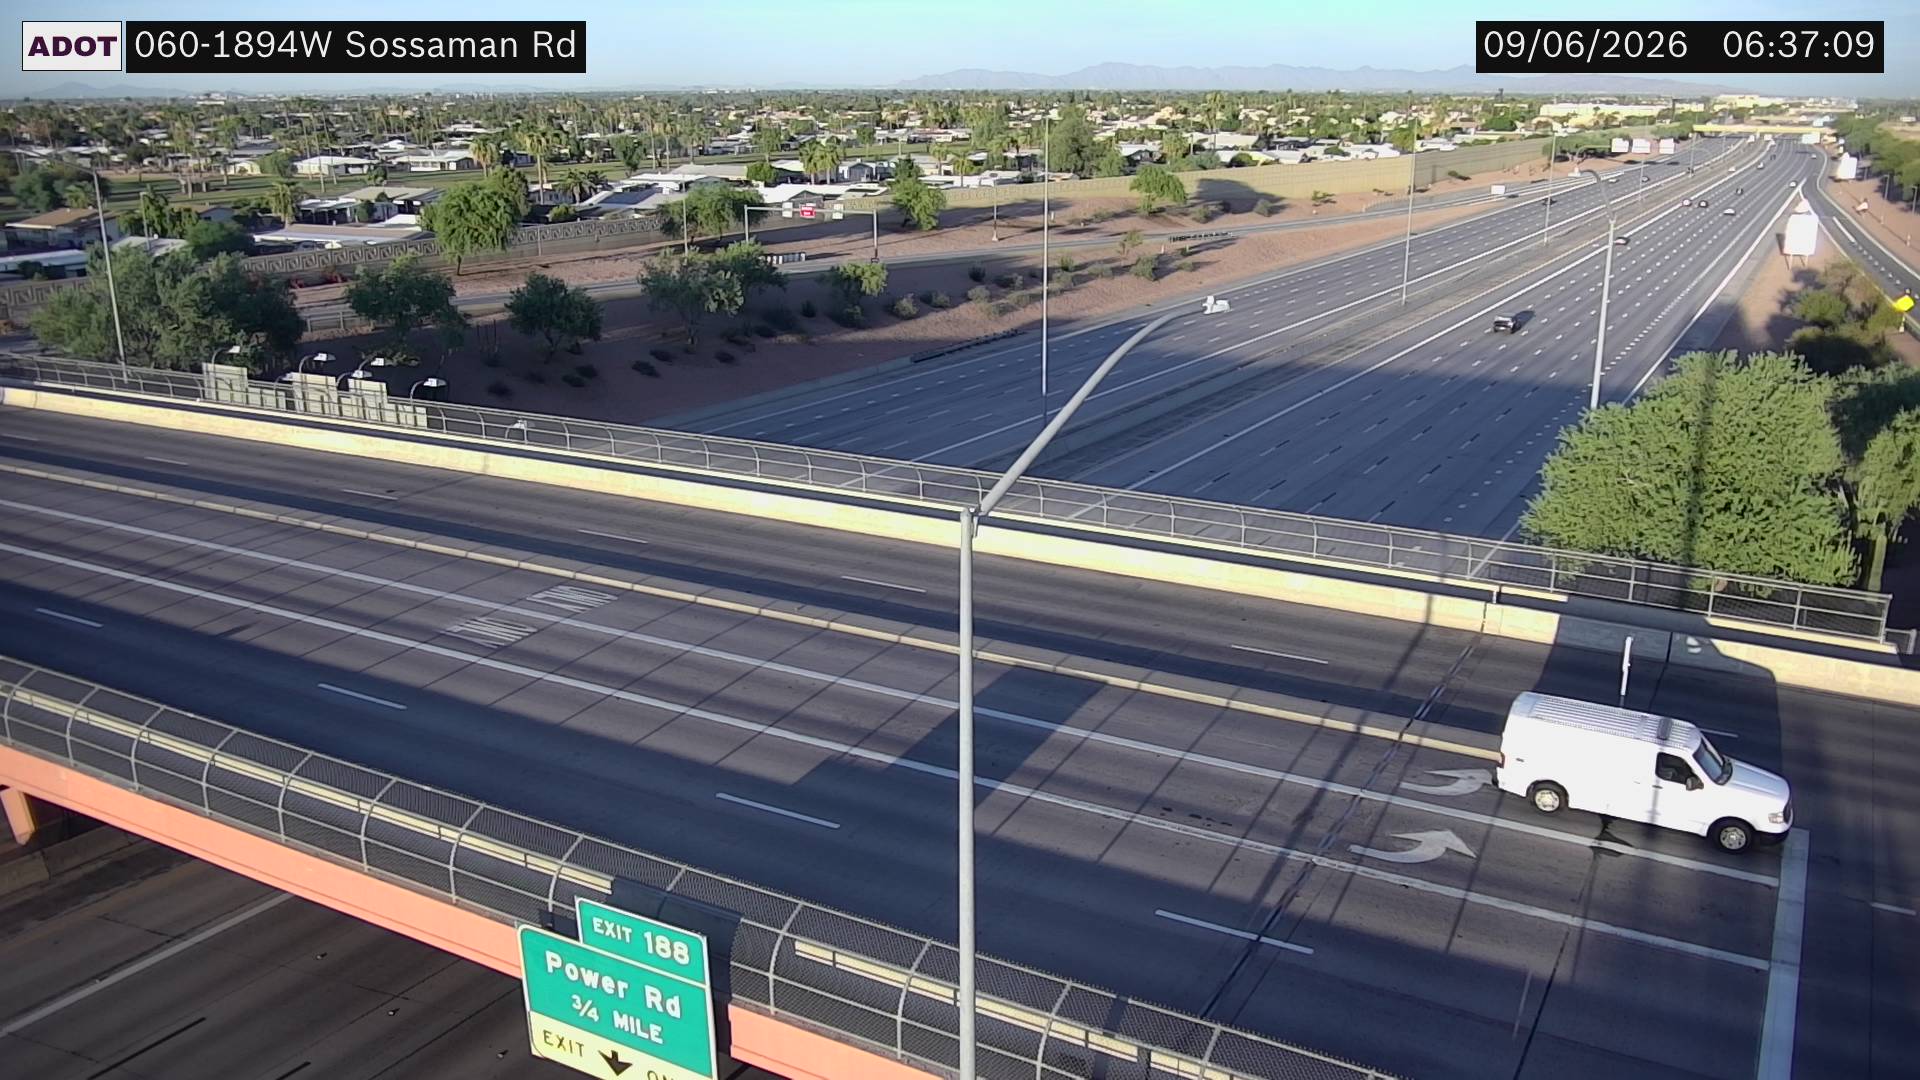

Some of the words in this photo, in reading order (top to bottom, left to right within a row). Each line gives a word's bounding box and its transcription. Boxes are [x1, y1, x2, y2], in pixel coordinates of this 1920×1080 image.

[592, 917, 632, 943] EXIT
[643, 932, 690, 965] 188
[545, 951, 629, 999] Power
[644, 985, 681, 1018] Rd
[543, 1030, 584, 1057] EXIT
[571, 994, 599, 1022] 3/4
[613, 1010, 664, 1044] MILE
